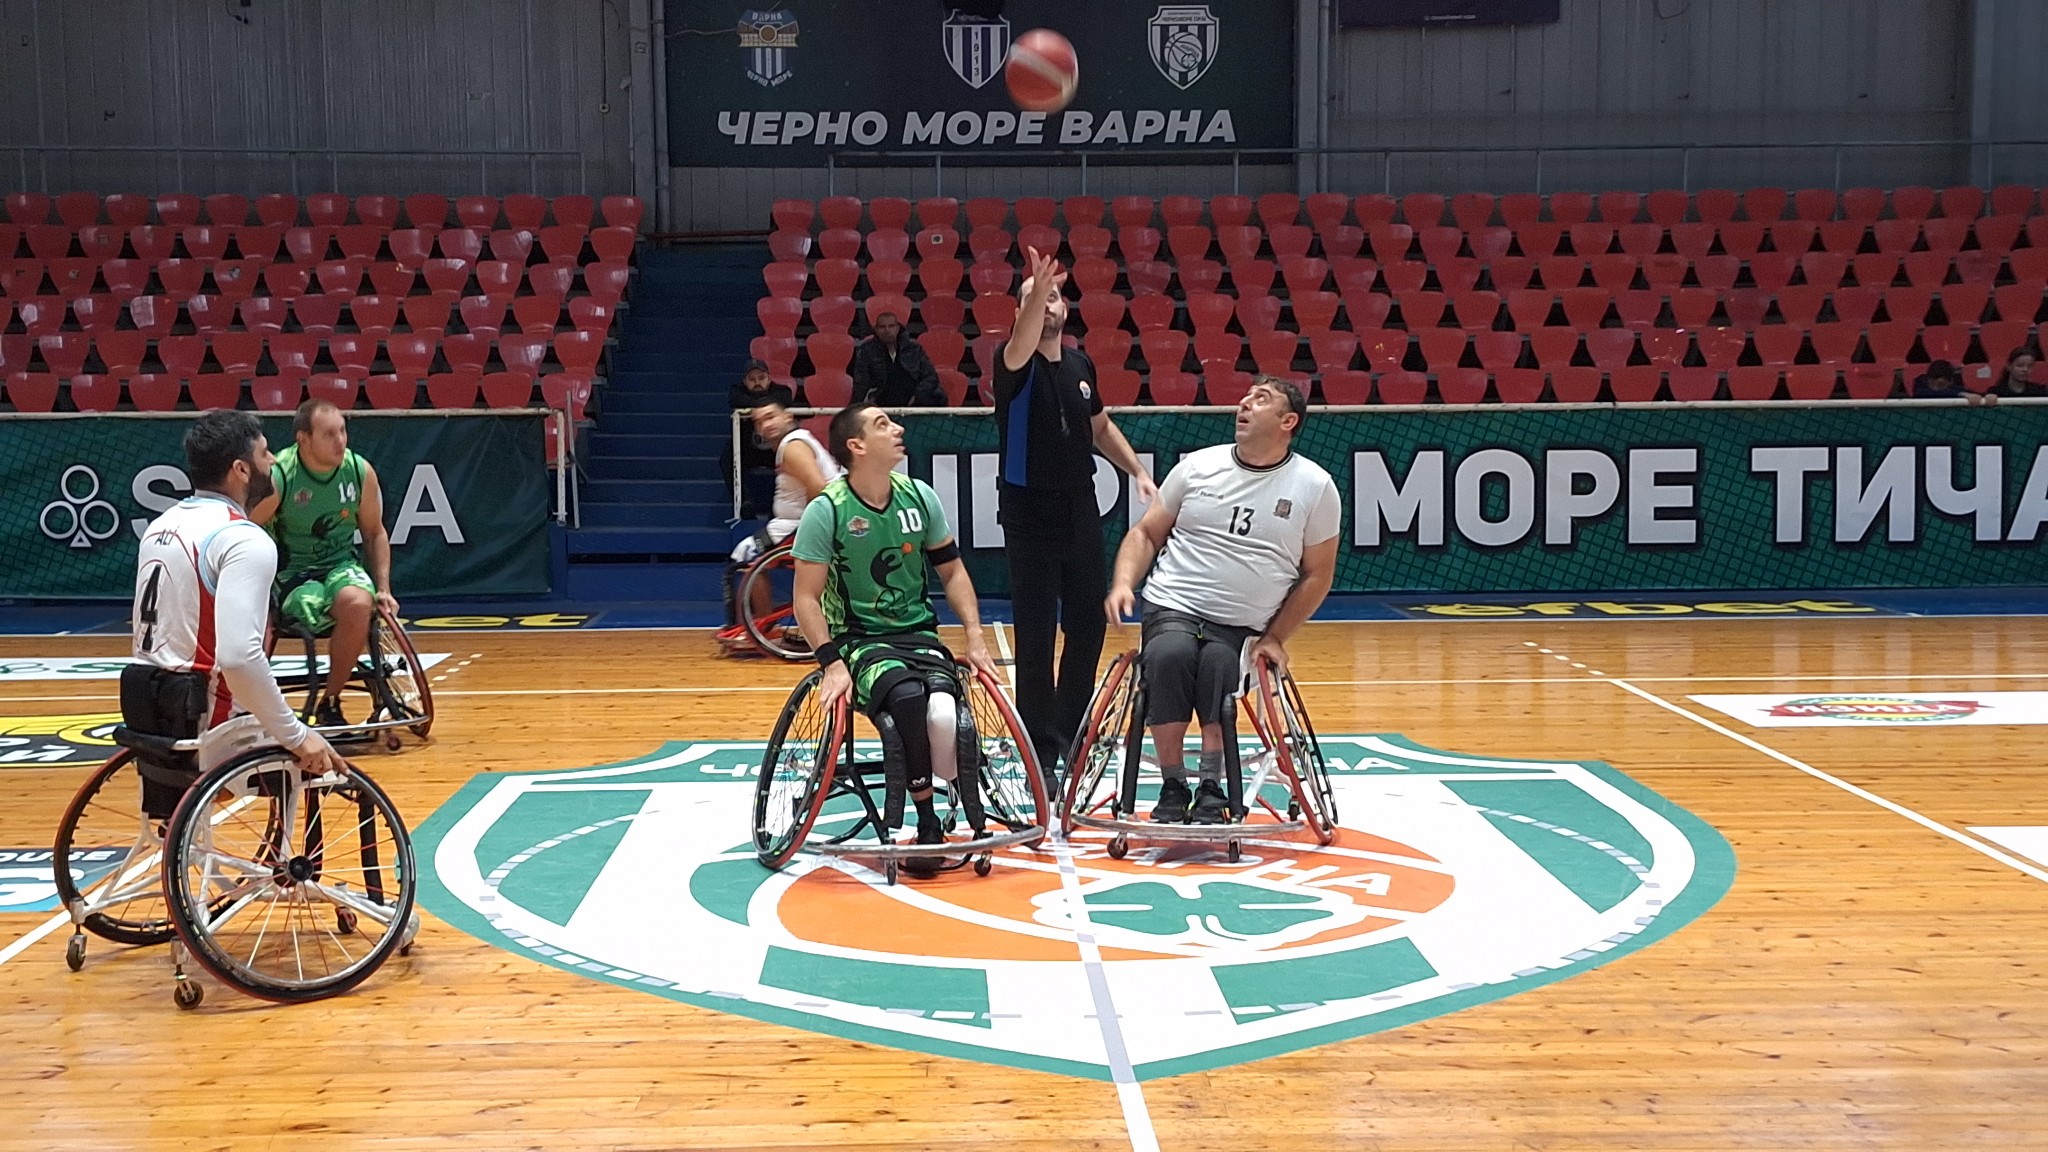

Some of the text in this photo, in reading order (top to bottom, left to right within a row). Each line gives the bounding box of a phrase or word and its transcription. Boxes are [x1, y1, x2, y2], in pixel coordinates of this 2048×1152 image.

[717, 109, 1237, 145] ЧЕРНО МОРЕ ВАРНА
[338, 482, 357, 504] 14
[1353, 448, 1698, 547] МОРЕ
[897, 507, 923, 534] 10
[1228, 506, 1255, 536] 13
[140, 563, 162, 653] 4
[1425, 600, 1877, 617] efbet
